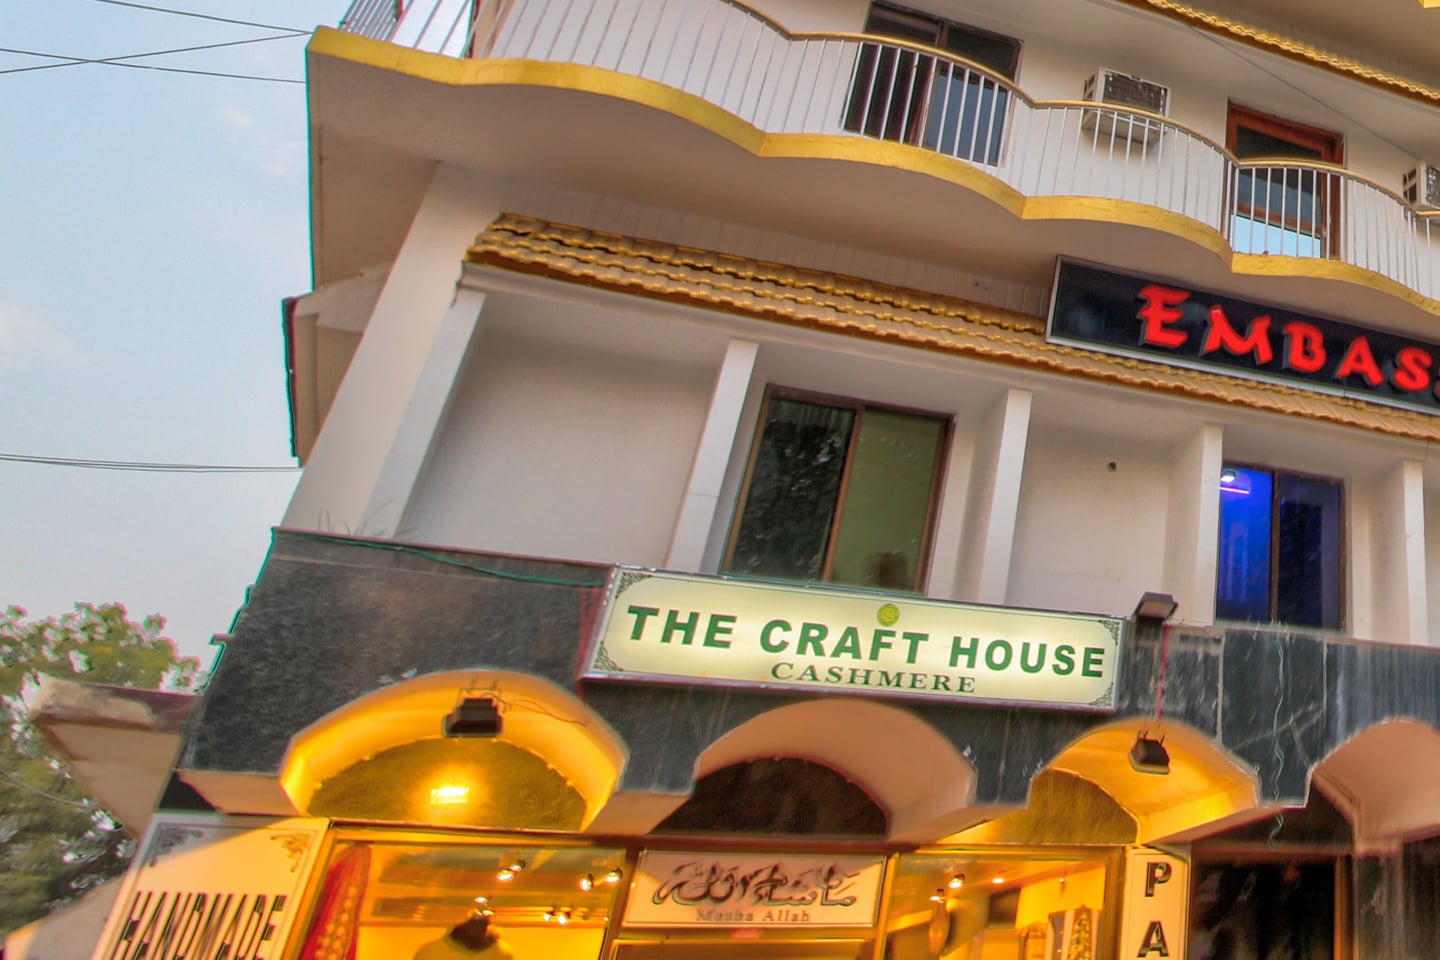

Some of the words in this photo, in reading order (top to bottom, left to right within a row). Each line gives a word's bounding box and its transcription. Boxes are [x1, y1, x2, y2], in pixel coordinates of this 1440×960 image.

[627, 604, 738, 649] THE
[759, 619, 929, 665] CRAFT
[948, 635, 1106, 678] HOUSE
[771, 661, 976, 693] CASHMERE
[104, 891, 287, 960] HANDMADE
[762, 909, 811, 922] Allah
